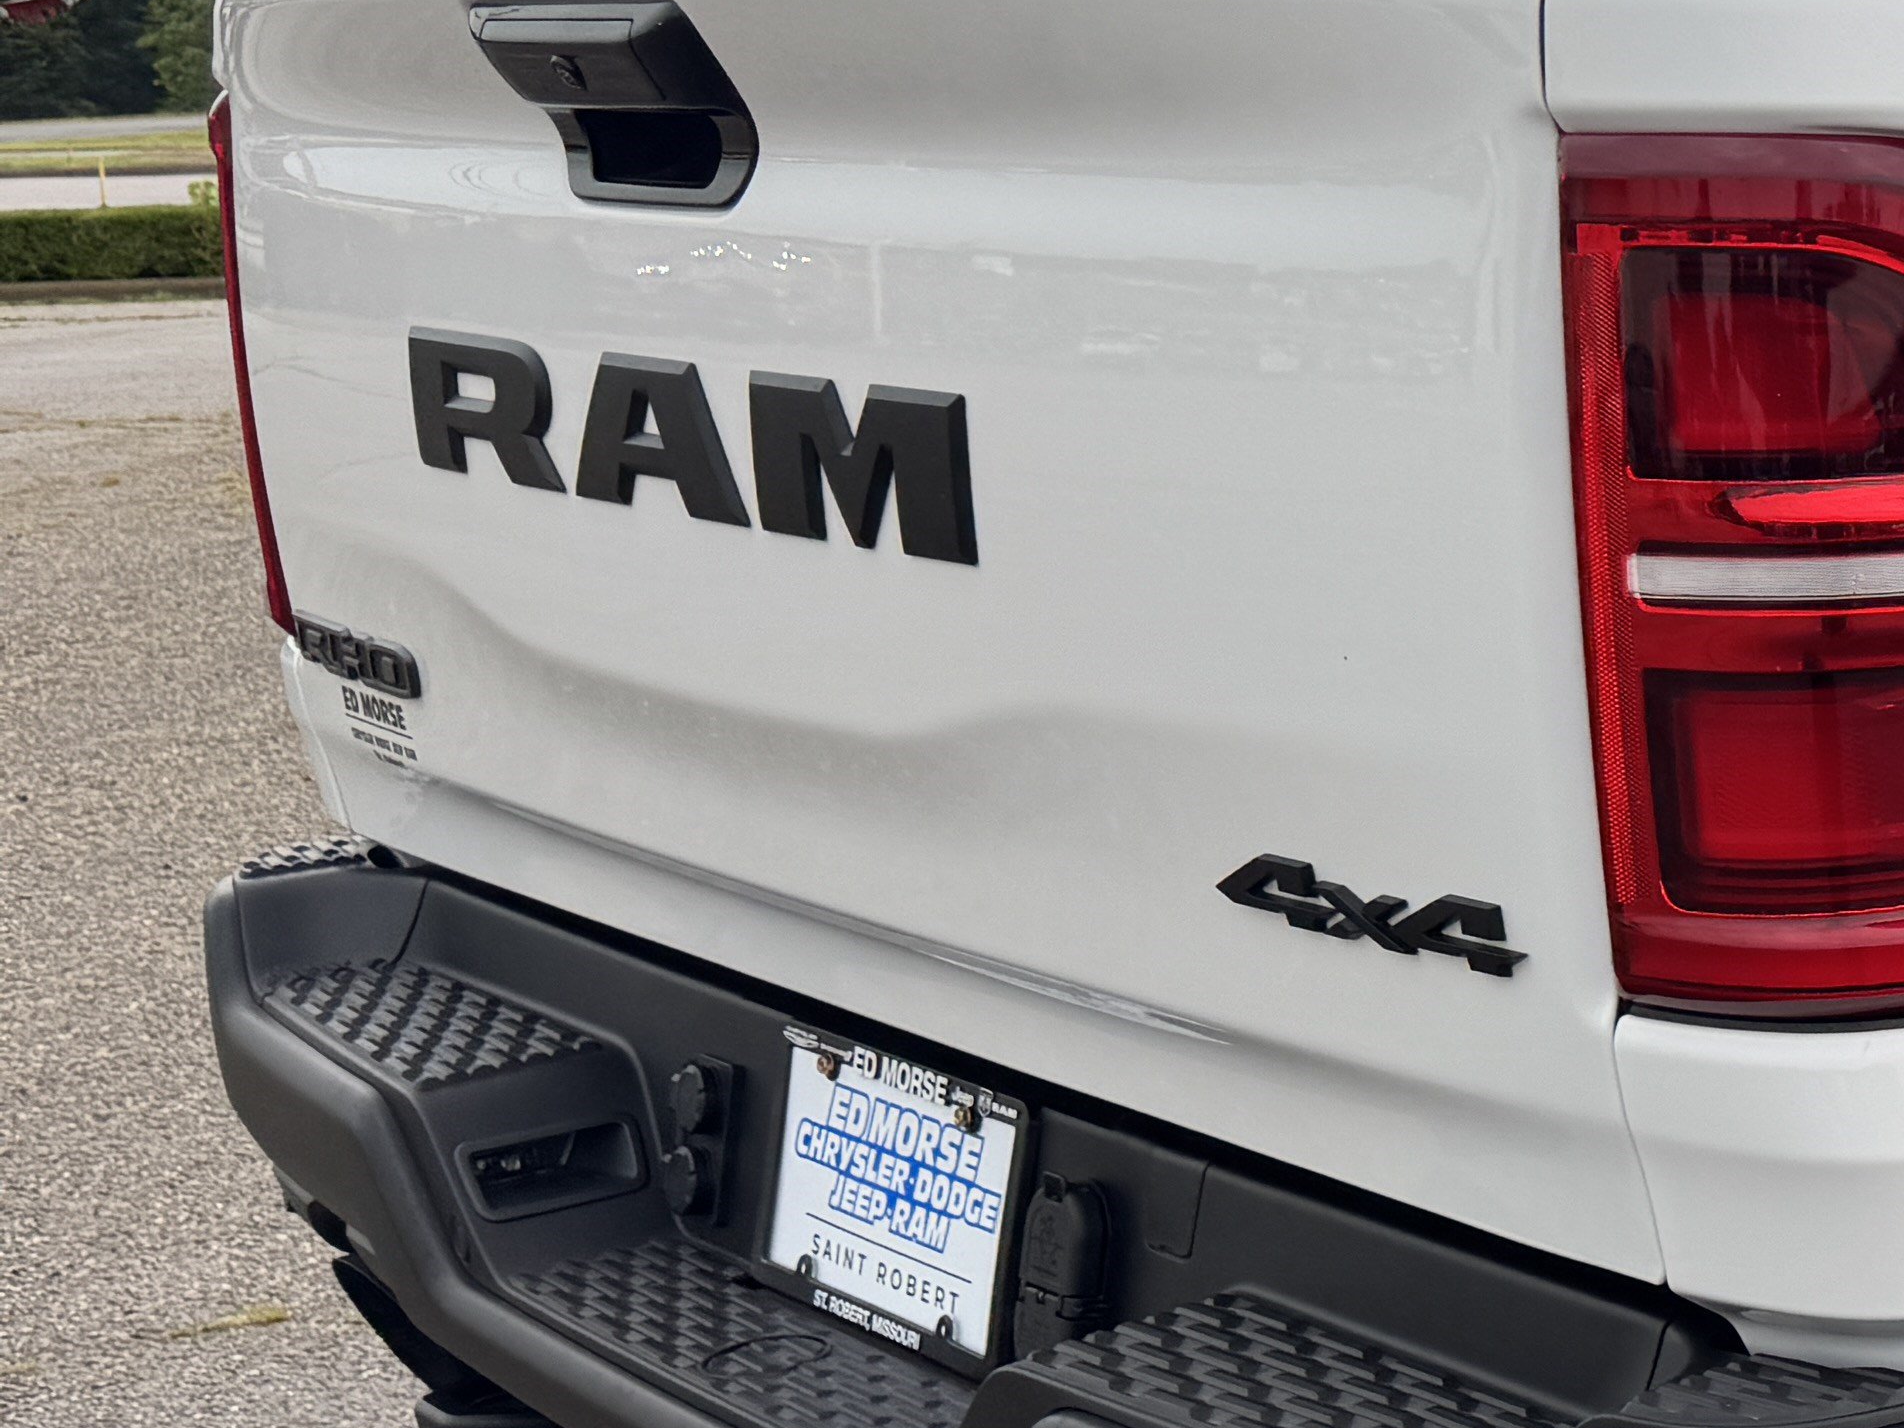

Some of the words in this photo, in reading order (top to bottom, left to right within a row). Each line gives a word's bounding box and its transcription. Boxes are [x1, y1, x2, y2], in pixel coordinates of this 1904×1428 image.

[408, 326, 979, 566] RAM
[341, 685, 359, 713] ED
[360, 691, 407, 731] MORSE
[853, 1046, 877, 1079] ED
[881, 1056, 949, 1106] MORSE
[827, 1082, 871, 1143] ED
[867, 1096, 984, 1183] MORSE
[811, 1233, 867, 1276] SAINT
[876, 1262, 960, 1315] ROBERT
[872, 1313, 921, 1351] MISSOURI
